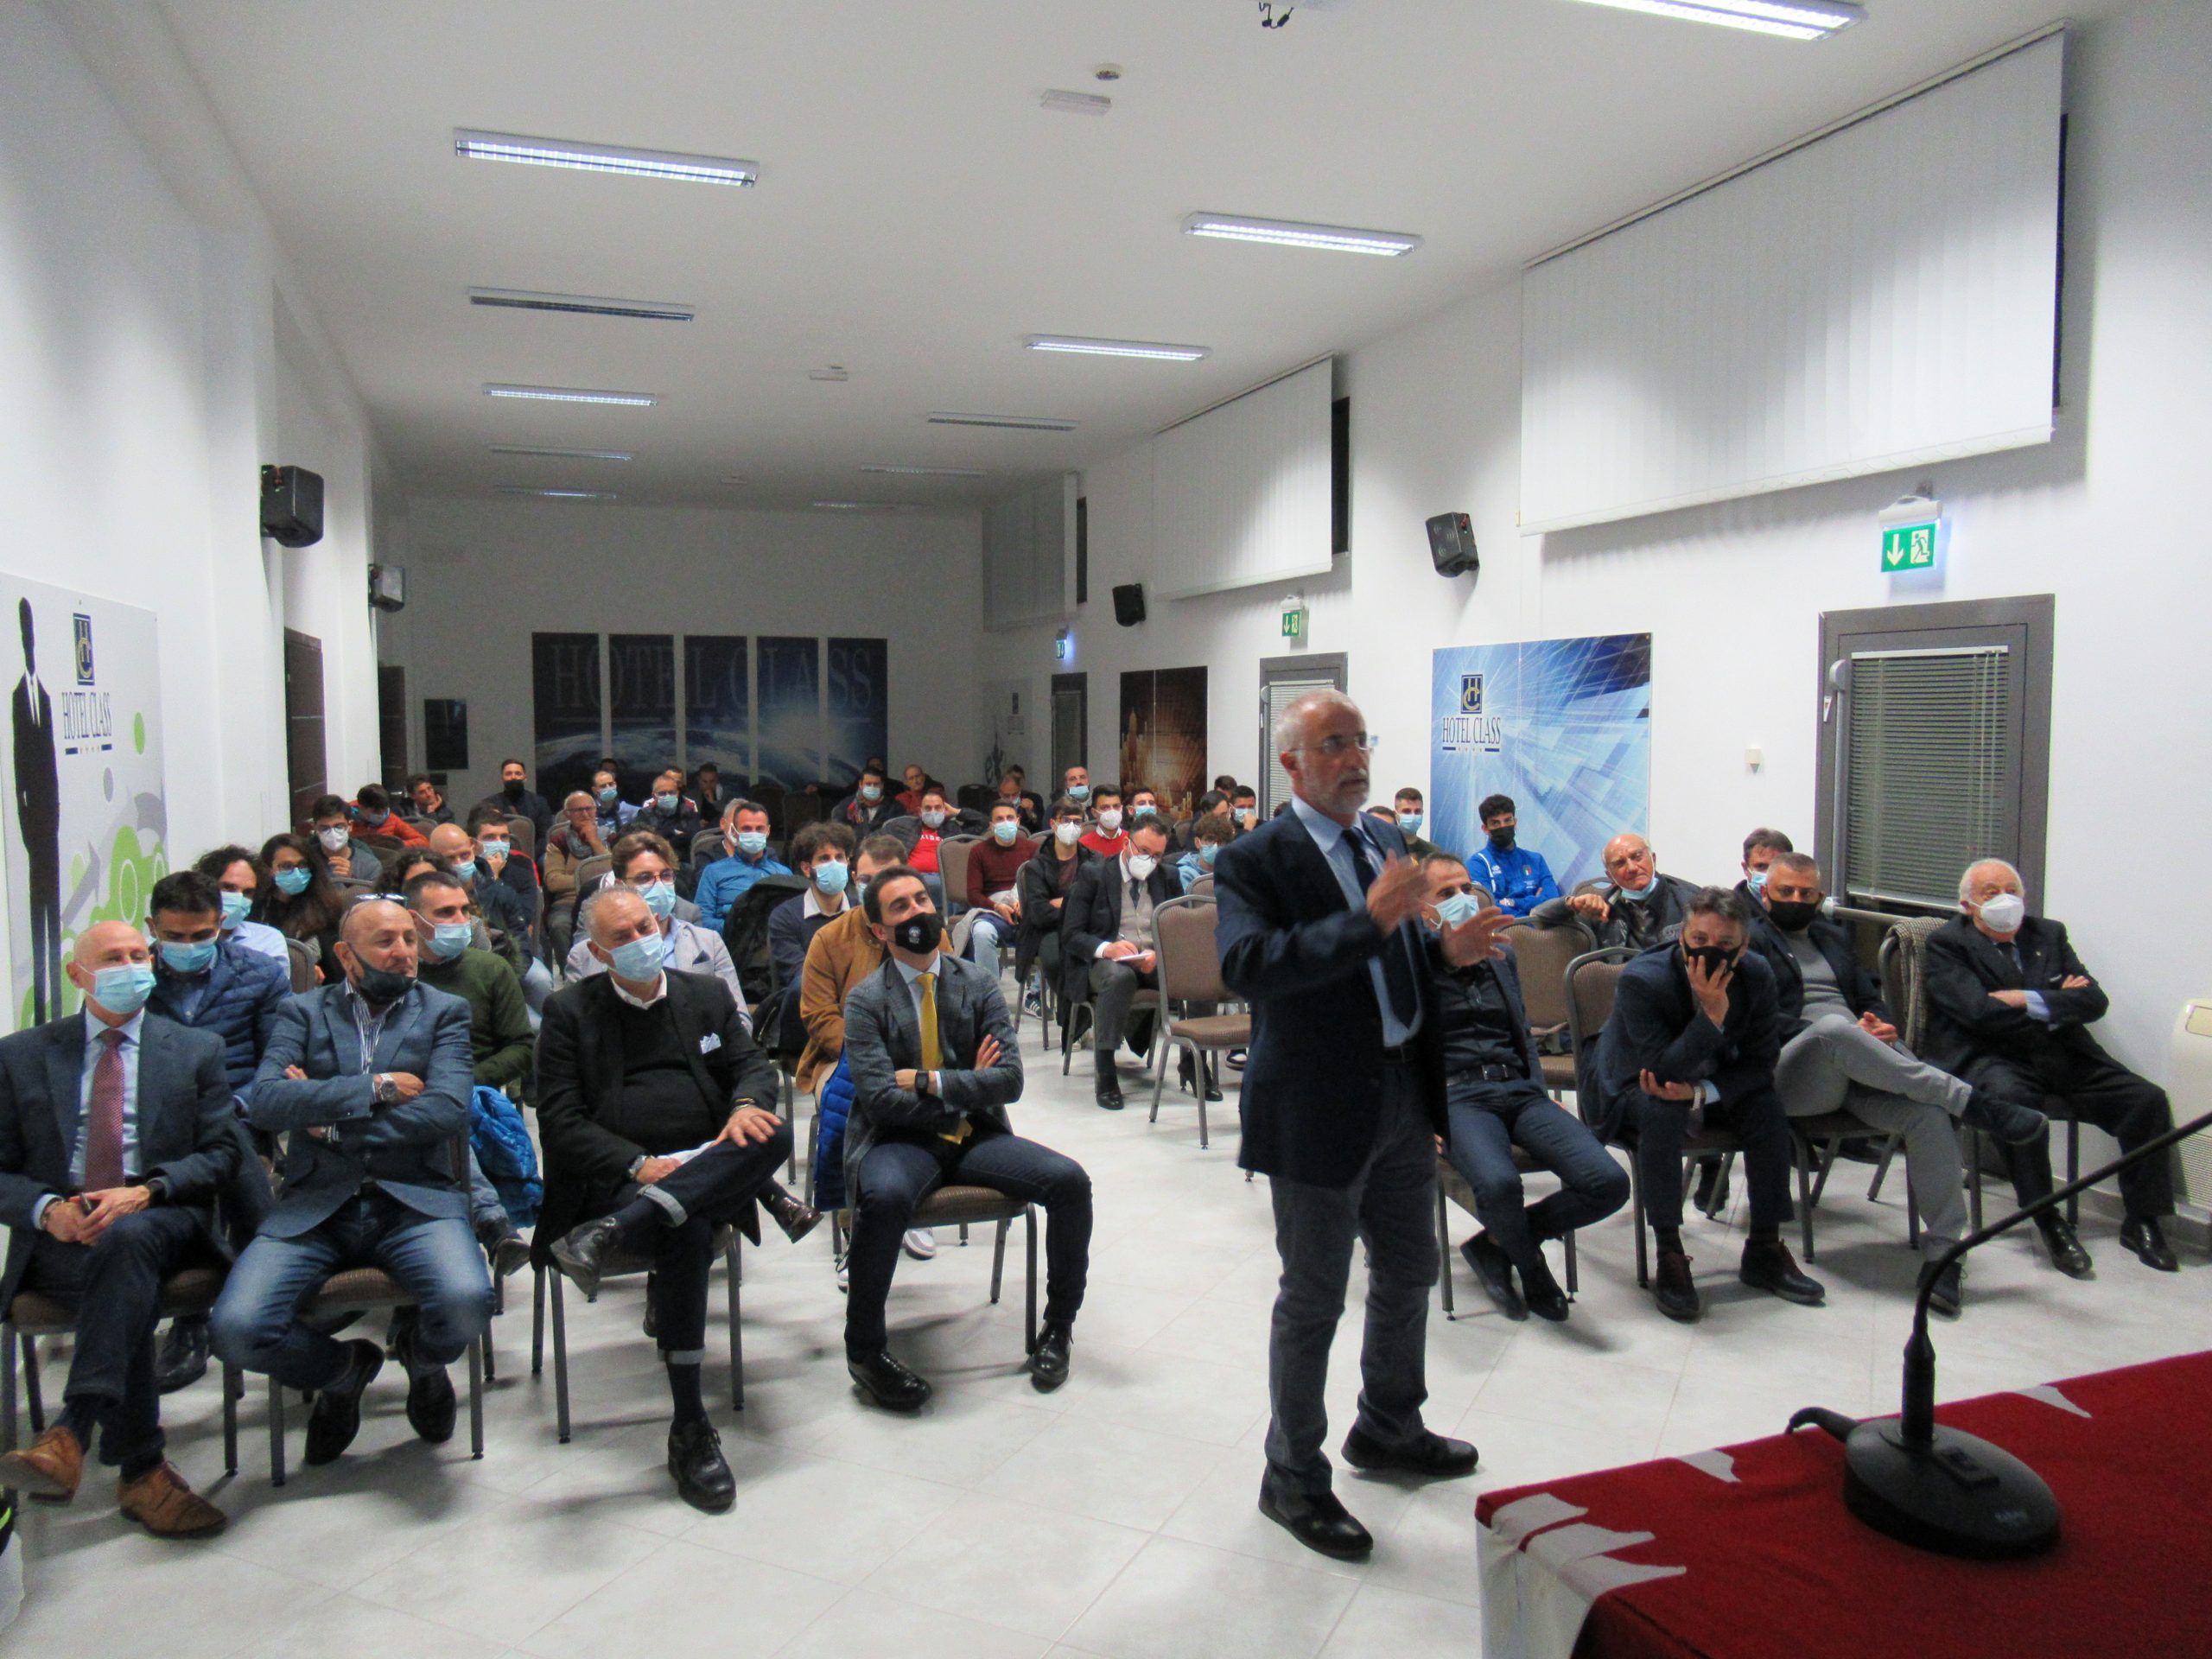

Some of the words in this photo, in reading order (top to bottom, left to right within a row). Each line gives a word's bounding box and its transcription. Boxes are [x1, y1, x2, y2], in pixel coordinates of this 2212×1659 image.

[61, 691, 89, 739] HOTEL
[1442, 717, 1471, 743] HOTEL
[1473, 717, 1501, 744] CLASS
